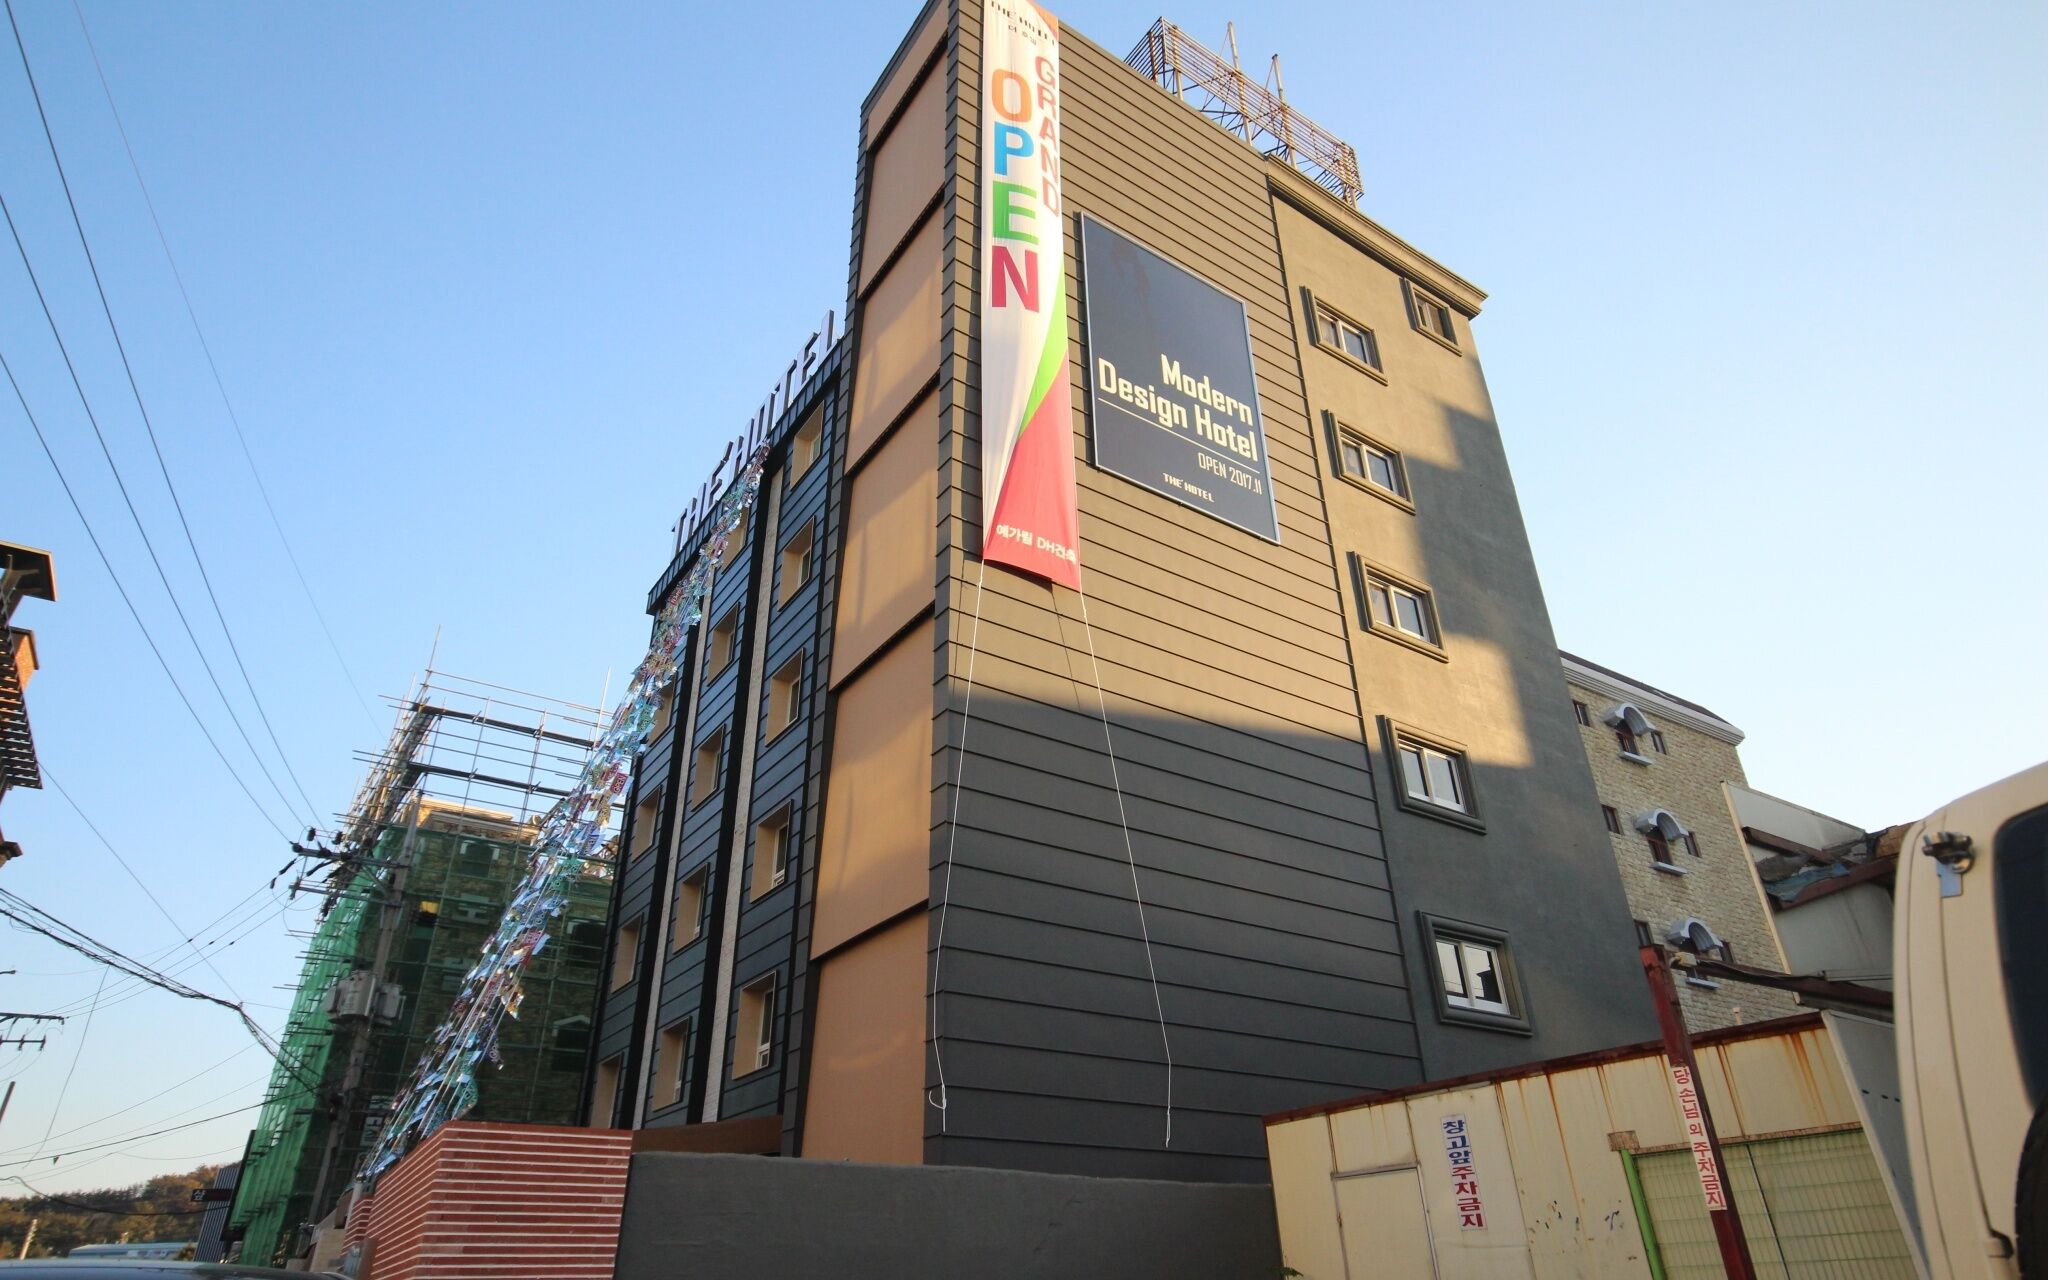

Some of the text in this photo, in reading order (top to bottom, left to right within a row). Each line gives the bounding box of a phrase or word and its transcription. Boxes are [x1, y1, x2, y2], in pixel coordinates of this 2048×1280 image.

[1035, 55, 1060, 218] GRAND
[991, 68, 1040, 313] OPEN
[1098, 357, 1259, 462] Design Hotel
[1160, 352, 1254, 428] Modern
[1184, 482, 1215, 503] HOTEL
[1197, 452, 1263, 495] OPEN 2017.11
[1672, 1068, 1727, 1208] 당 손님 외 주차금지
